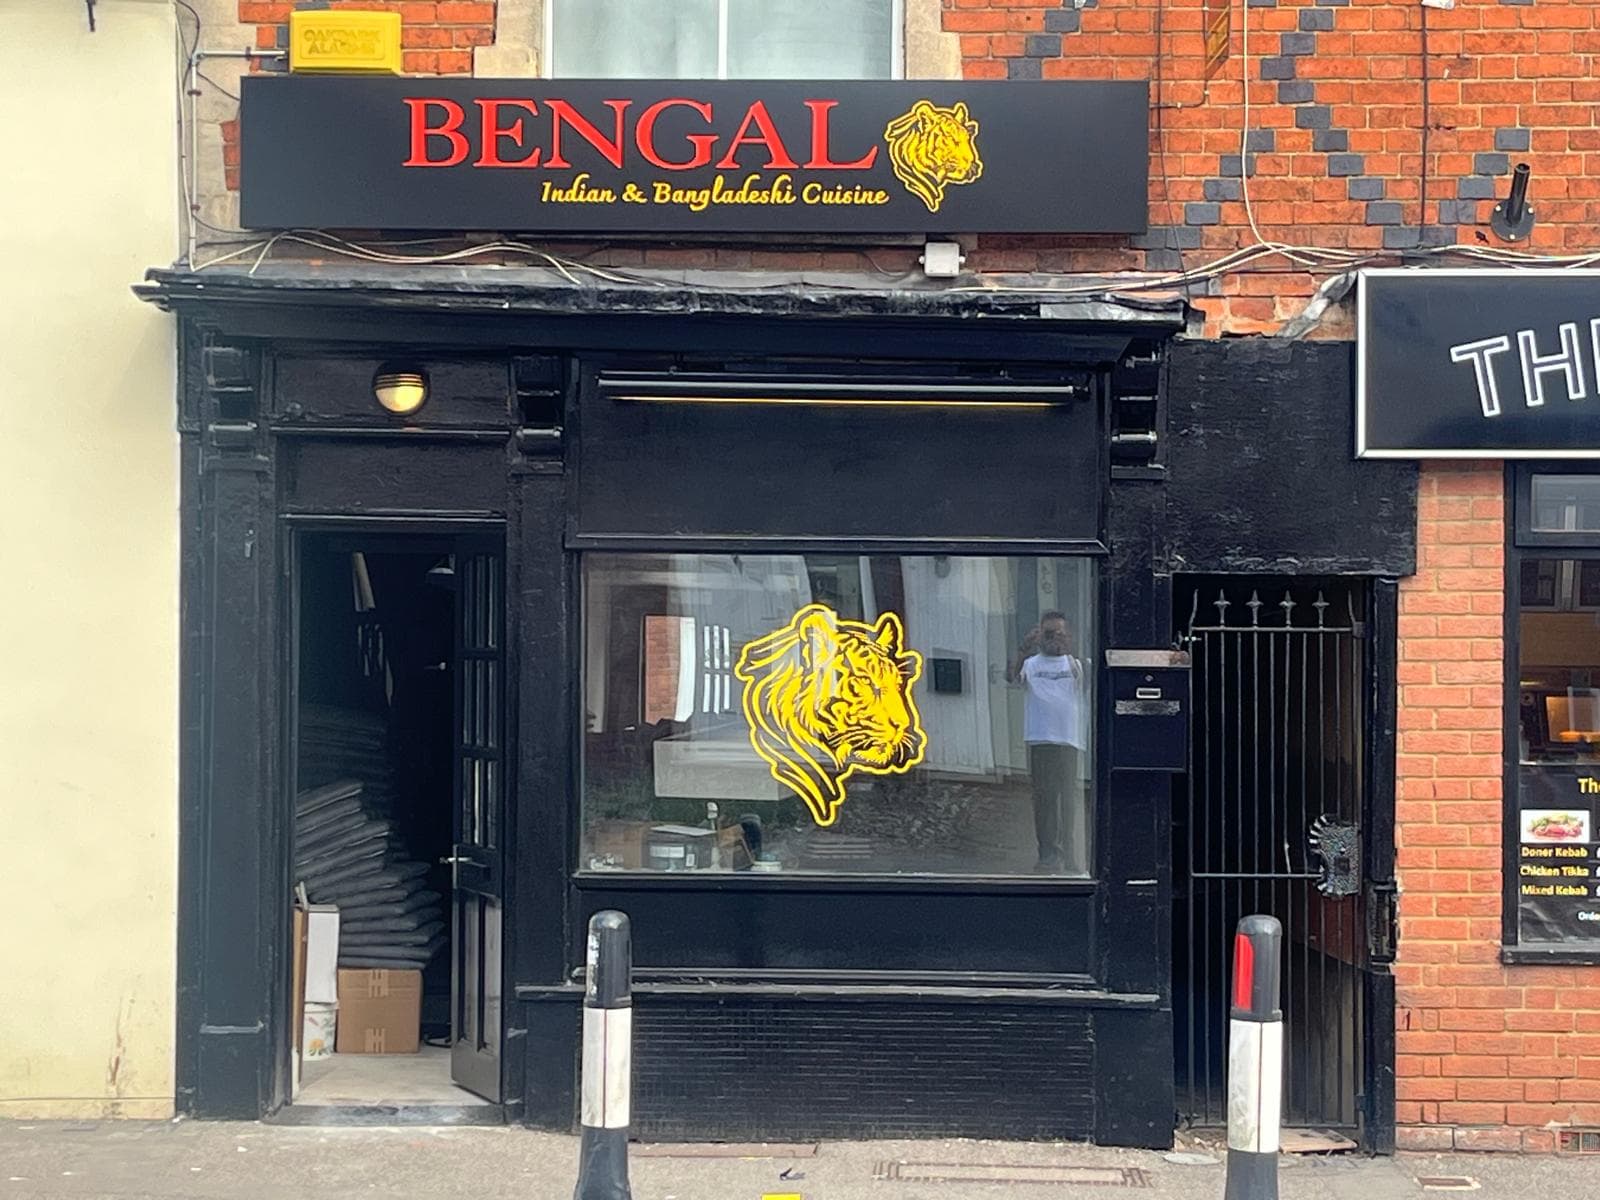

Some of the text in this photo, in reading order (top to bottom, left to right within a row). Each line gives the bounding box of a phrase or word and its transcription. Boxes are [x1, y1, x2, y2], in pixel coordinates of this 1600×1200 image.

[404, 98, 878, 170] BENGAL
[542, 173, 890, 212] Indian & Bangladeshi Cuisine
[1450, 318, 1600, 417] TH
[1578, 777, 1600, 794] Th
[1521, 846, 1553, 858] Doner
[1555, 846, 1588, 858] Kebab
[1520, 865, 1560, 877] Chicken
[1561, 865, 1589, 877] Tikka
[1521, 884, 1554, 896] Mixed
[1556, 884, 1588, 896] Kebab
